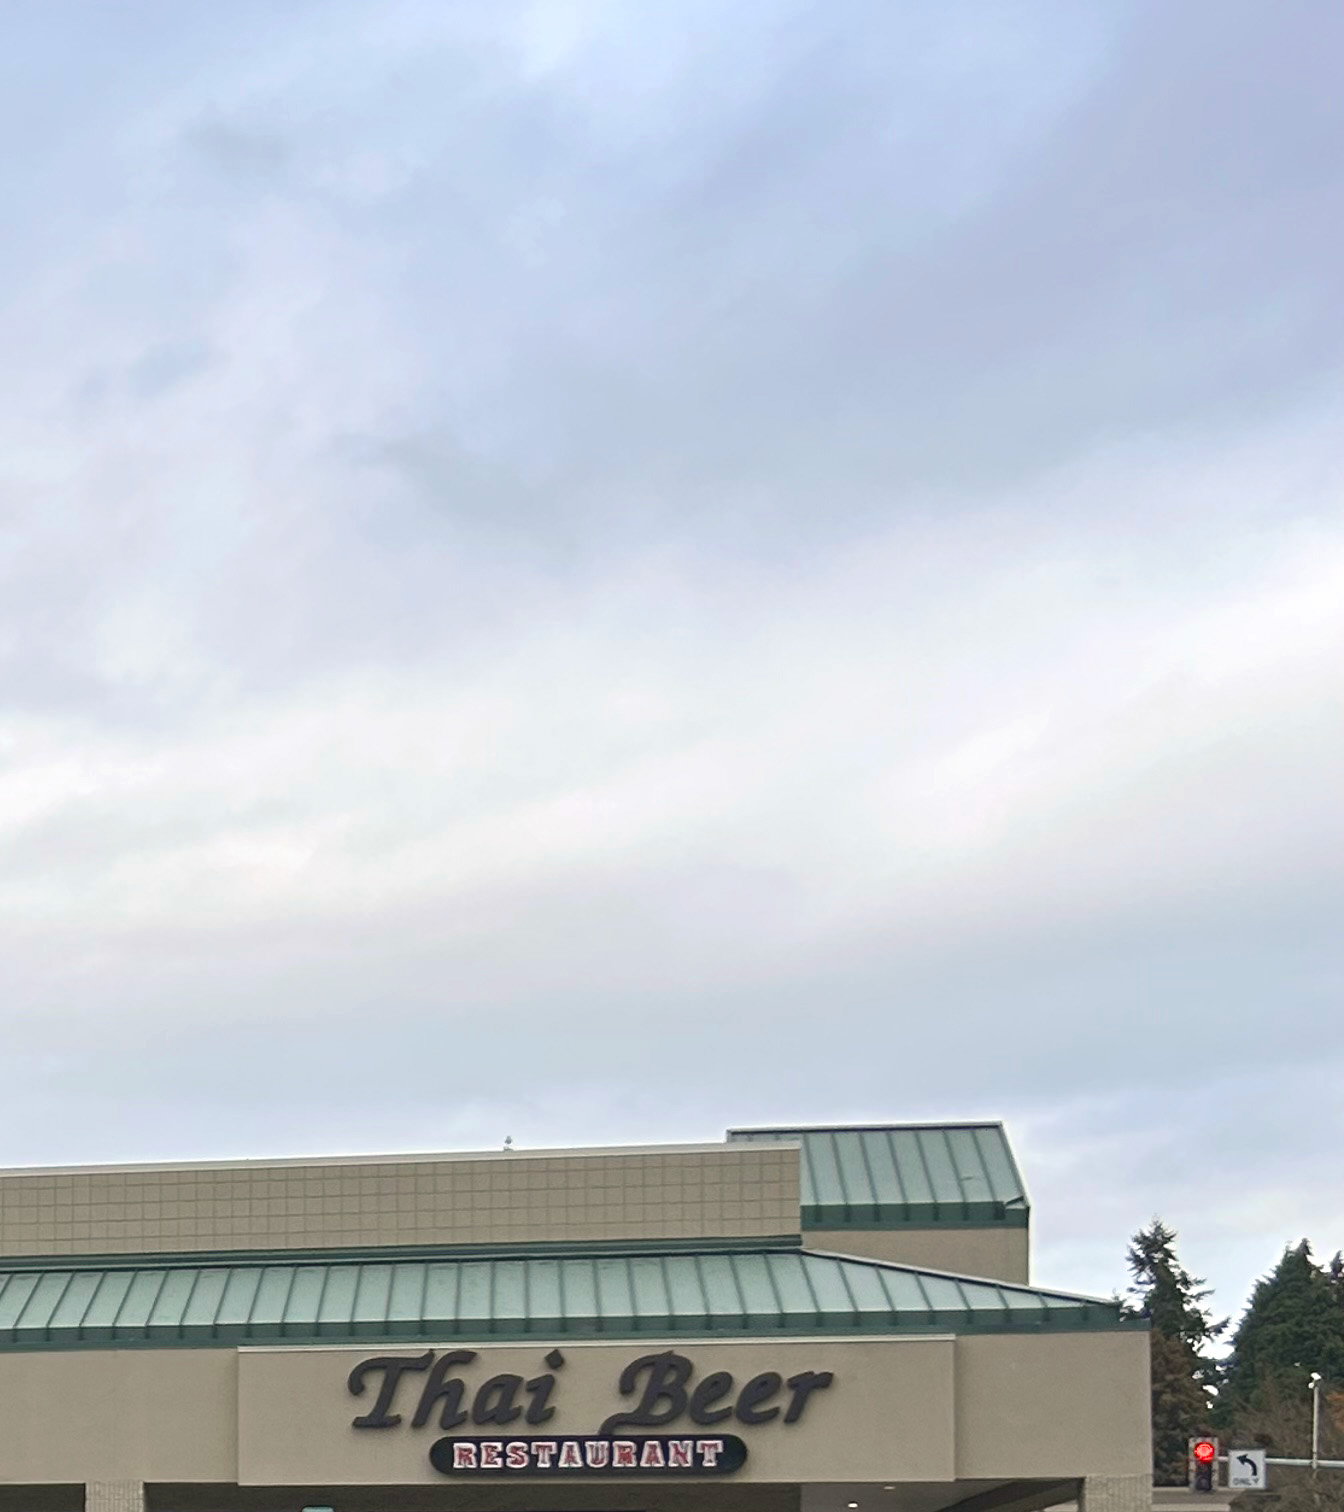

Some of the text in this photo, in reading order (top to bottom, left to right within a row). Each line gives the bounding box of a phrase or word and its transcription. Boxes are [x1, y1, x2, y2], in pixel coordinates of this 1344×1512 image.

[347, 1348, 834, 1435] Thai Beer
[452, 1439, 725, 1470] RESTAURANT
[1231, 1477, 1260, 1486] ONLY
